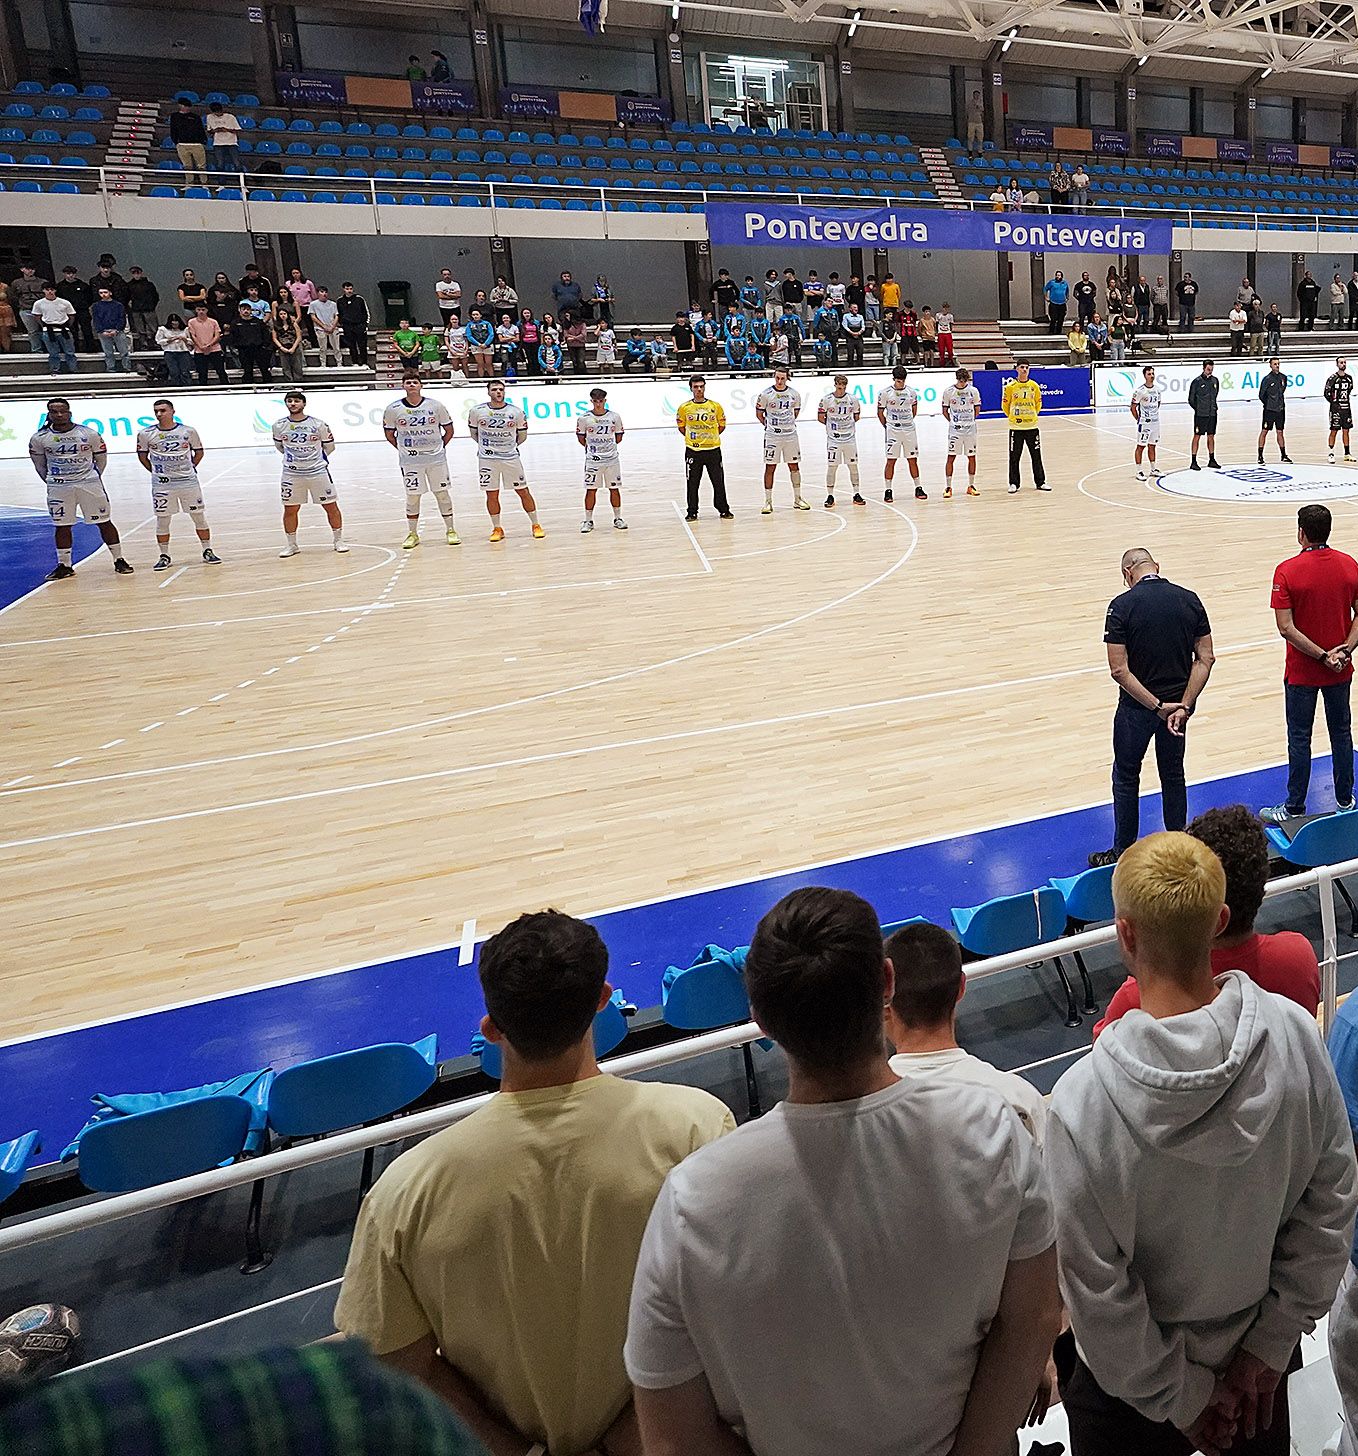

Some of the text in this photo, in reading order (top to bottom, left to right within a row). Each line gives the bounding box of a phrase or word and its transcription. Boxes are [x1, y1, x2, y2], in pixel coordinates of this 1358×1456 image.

[745, 213, 928, 242] Pontevedra
[994, 221, 1146, 249] Pontevedra
[1221, 372, 1235, 390] &
[779, 401, 790, 410] 14
[899, 398, 906, 406] 7
[960, 397, 966, 406] 5
[838, 406, 847, 415] 11
[410, 416, 427, 427] 24
[696, 413, 708, 422] 16
[488, 419, 506, 429] 22
[596, 425, 609, 434] 21
[291, 433, 308, 443] 23
[56, 444, 78, 454] 44
[886, 443, 893, 452] 7
[764, 449, 775, 458] 14
[827, 451, 836, 460] 11
[584, 473, 597, 483] 21
[405, 478, 419, 488] 24
